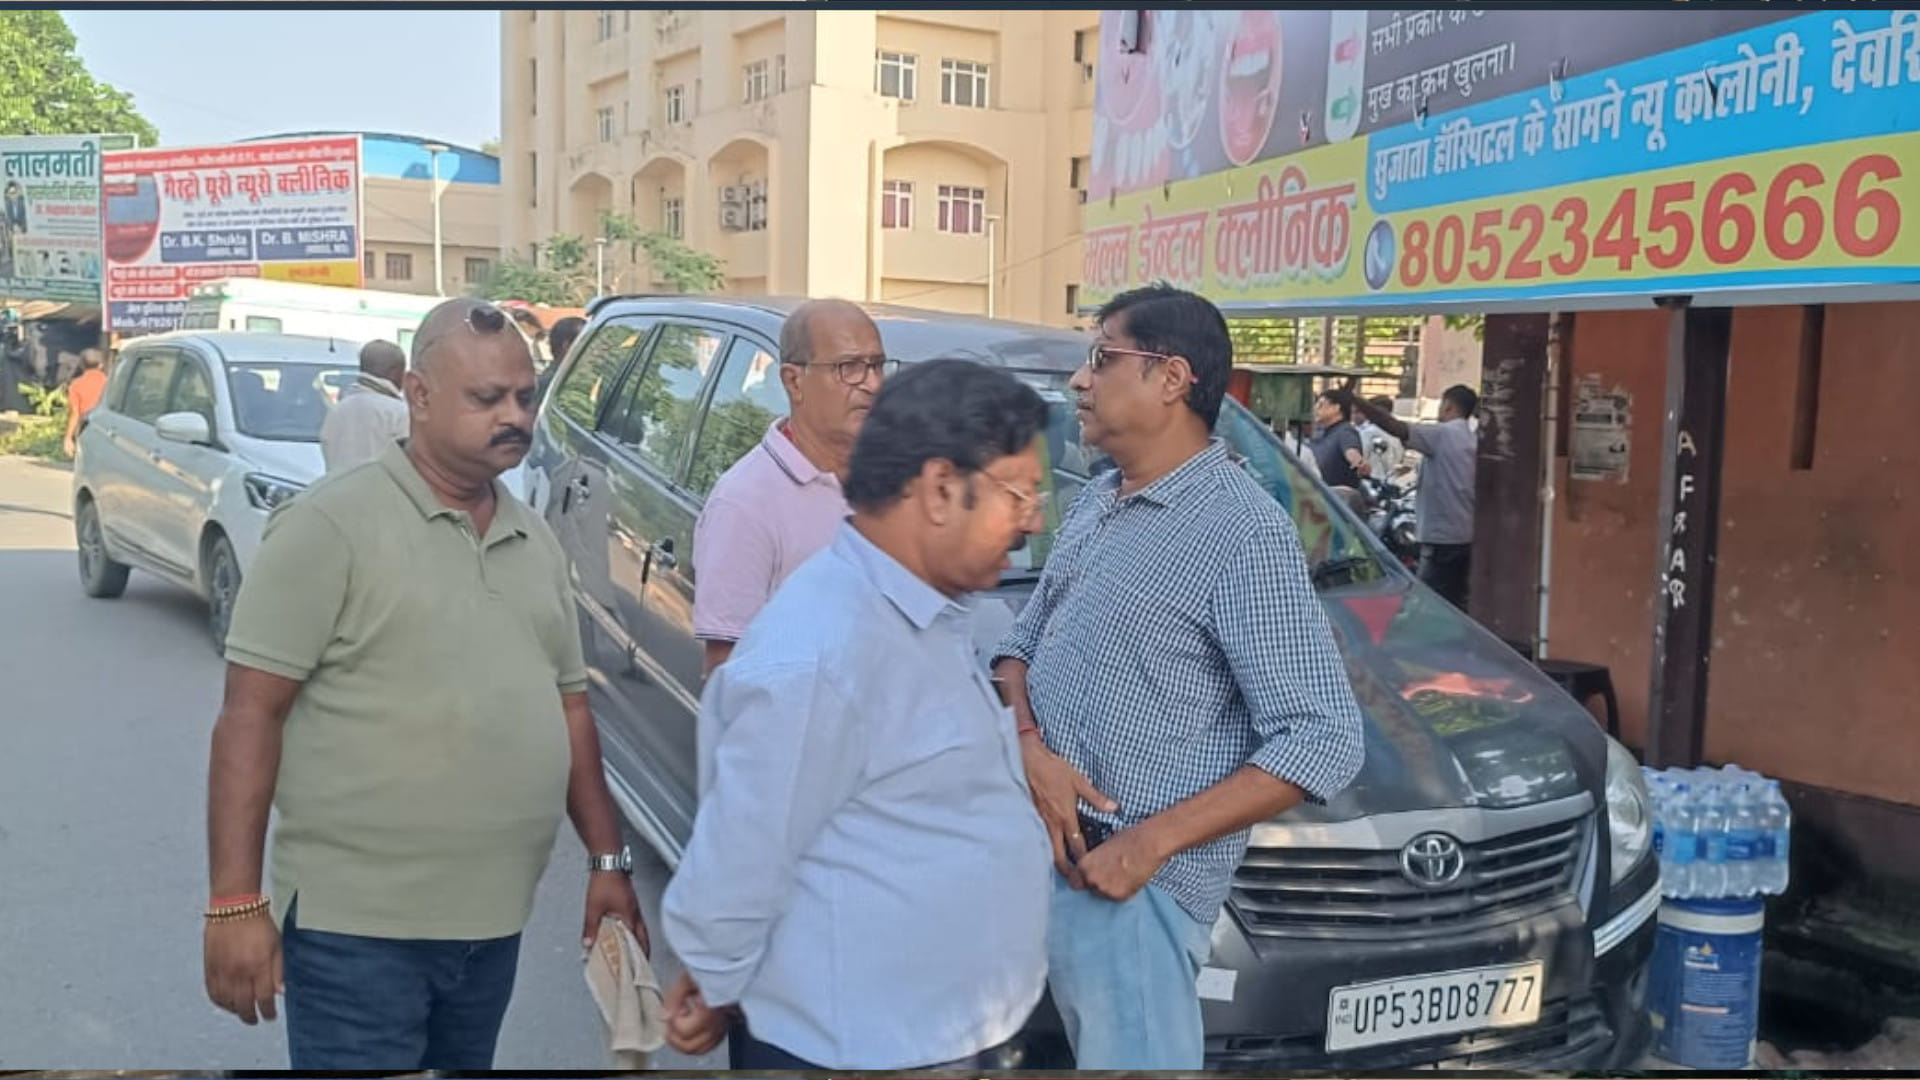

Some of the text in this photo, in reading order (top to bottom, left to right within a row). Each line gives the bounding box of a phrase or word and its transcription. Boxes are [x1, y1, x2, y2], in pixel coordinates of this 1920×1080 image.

[1372, 12, 1402, 55] सभी
[1367, 82, 1393, 122] मुख
[2, 140, 97, 178] लालमती
[1374, 138, 1431, 200] सुजाता
[1434, 117, 1518, 175] हॉस्पिटल
[1523, 98, 1548, 156] के
[1552, 78, 1626, 151] सामने
[1631, 79, 1669, 152] न्यू
[162, 236, 179, 248] Dr.
[206, 233, 248, 247] Shukla
[261, 232, 277, 245] Dr.
[298, 229, 348, 243] MISHRA
[1214, 165, 1355, 280] क्लीनिक
[1400, 154, 1903, 288] 8052345666
[1354, 976, 1535, 1034] UP53BD8777
